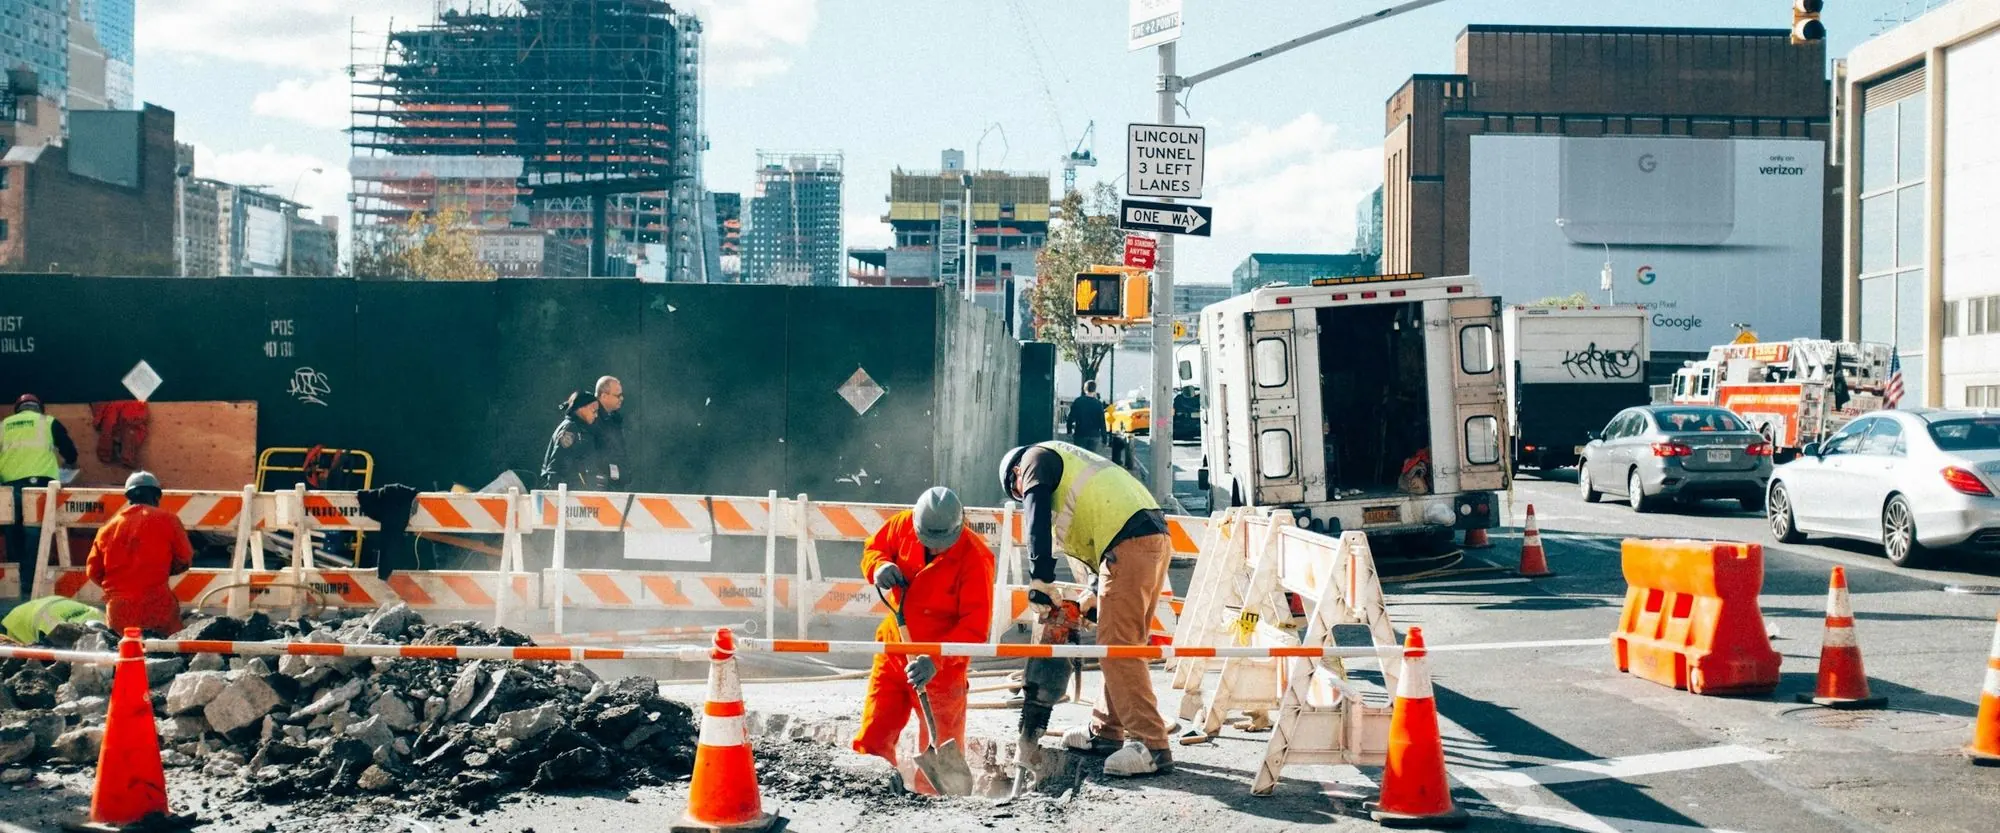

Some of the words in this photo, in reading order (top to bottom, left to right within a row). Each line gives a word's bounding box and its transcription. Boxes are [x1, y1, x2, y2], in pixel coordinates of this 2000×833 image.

[1135, 130, 1198, 144] LINCOLN
[1137, 146, 1195, 160] TUNNEL
[1138, 162, 1148, 174] 3
[1156, 163, 1192, 175] LEFT
[1759, 164, 1803, 175] verizon
[1140, 178, 1190, 192] LANES
[1134, 210, 1160, 223] ONE
[1171, 213, 1198, 226] WAY
[1129, 247, 1151, 256] ANYTIME
[1652, 313, 1702, 331] Google
[1, 337, 34, 353] BILLS
[64, 501, 105, 512] TRIUMPH
[566, 506, 599, 518] RIUMPH
[309, 582, 349, 594] TRIUMPH
